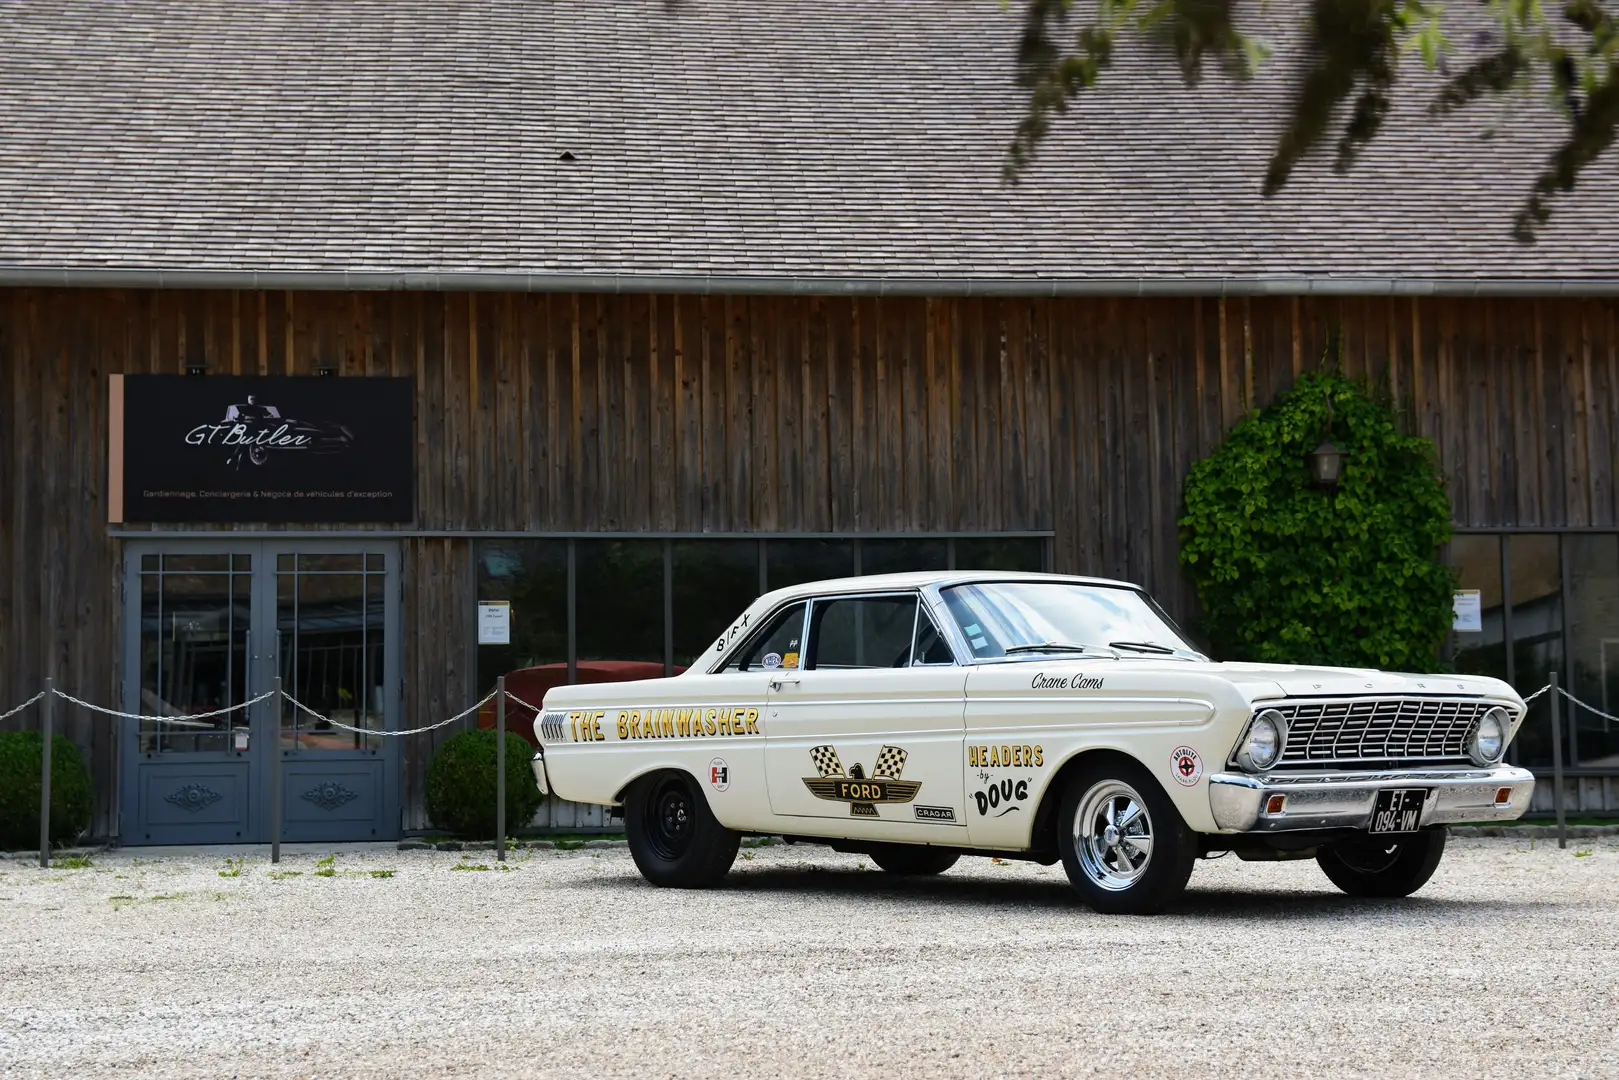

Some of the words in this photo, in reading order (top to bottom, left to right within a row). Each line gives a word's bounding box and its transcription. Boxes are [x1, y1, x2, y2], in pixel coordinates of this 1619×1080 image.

[184, 424, 231, 445] GT
[222, 423, 312, 445] Butler
[199, 489, 252, 499] Conciergerie
[293, 490, 305, 498] de
[1031, 672, 1068, 689] Crane
[1070, 672, 1105, 690] Cams
[569, 711, 606, 742] THE
[616, 707, 760, 740] BRAINWASHER
[968, 745, 1044, 768] HEADERS
[841, 783, 881, 799] FORD
[917, 808, 952, 819] CRAGAR
[1375, 810, 1418, 832] 094-VM
